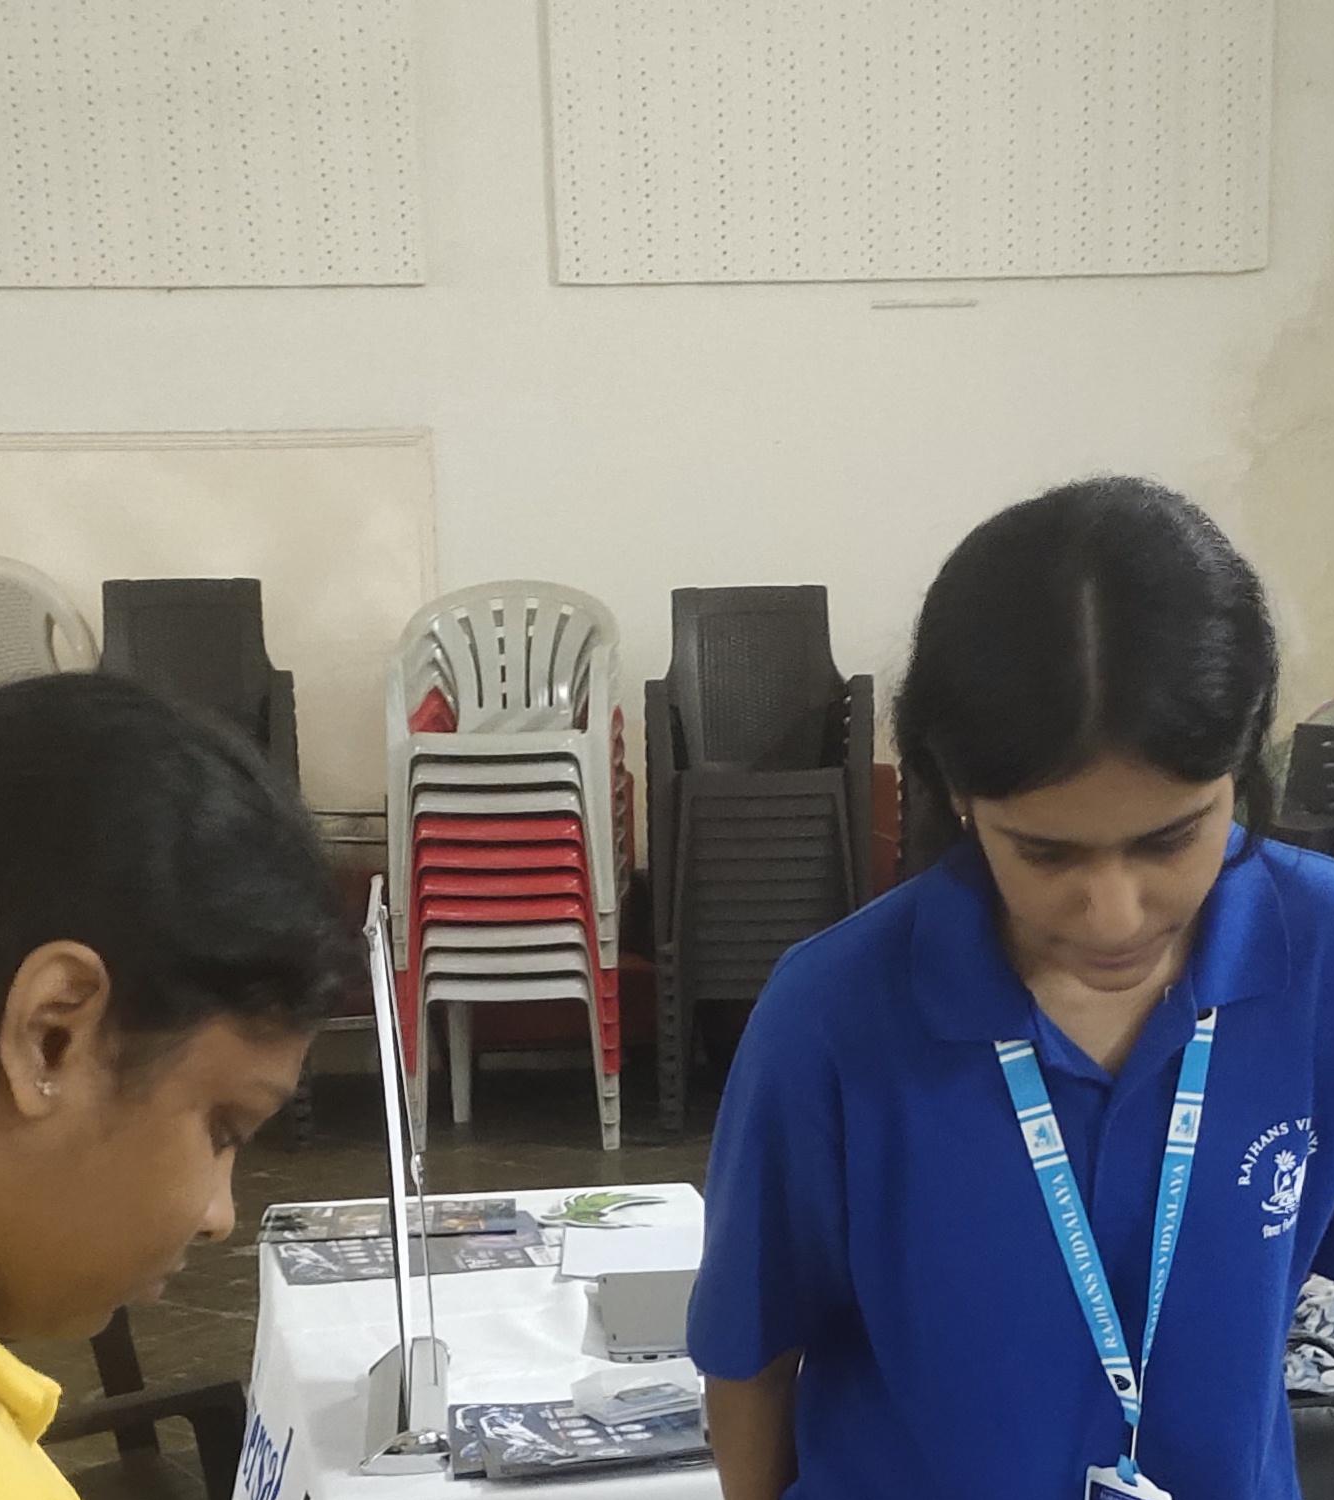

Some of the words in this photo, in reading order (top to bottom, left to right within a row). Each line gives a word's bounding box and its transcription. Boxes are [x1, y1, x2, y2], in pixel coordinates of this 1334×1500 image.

[1237, 1122, 1289, 1186] RAJHANS
[1052, 1173, 1092, 1271] VIDYALAYA
[1083, 1272, 1117, 1349] RAJHANS
